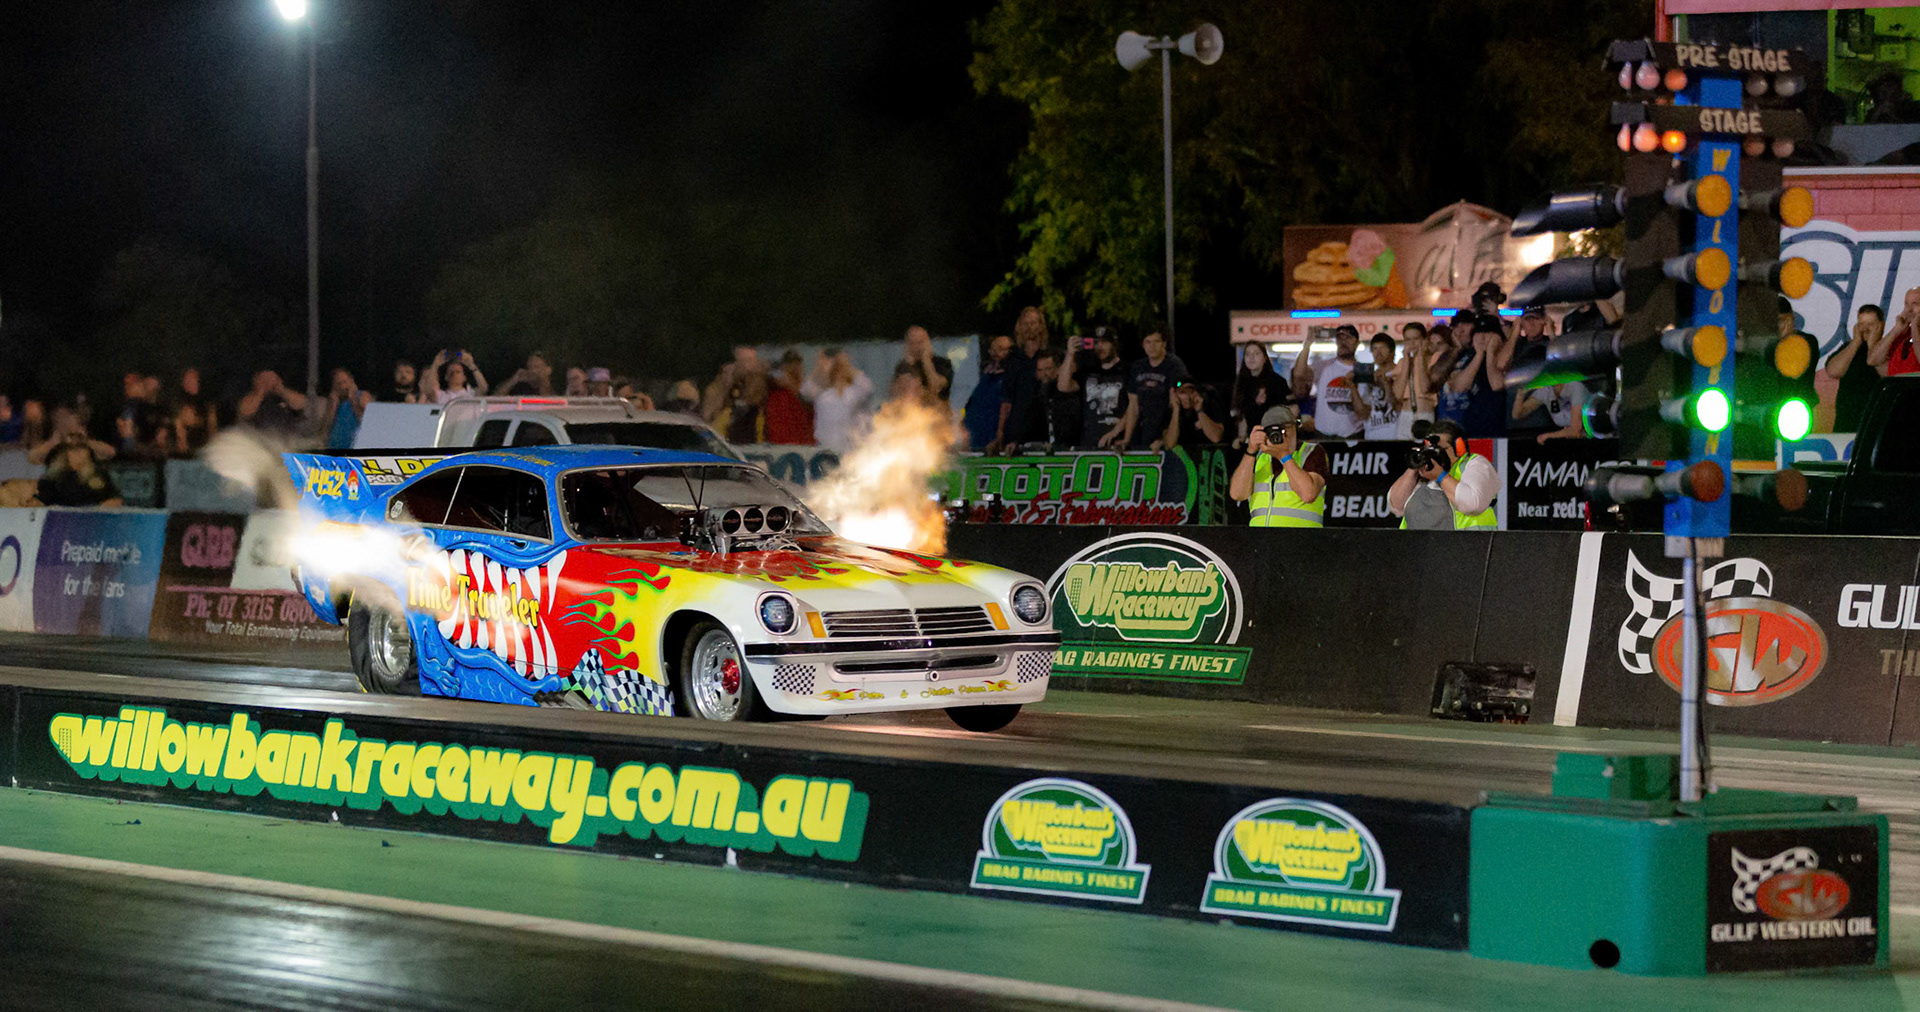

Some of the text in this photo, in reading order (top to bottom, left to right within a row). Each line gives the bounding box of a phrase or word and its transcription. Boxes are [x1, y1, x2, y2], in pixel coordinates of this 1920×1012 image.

[1675, 45, 1791, 72] PRE-STAGE
[1699, 110, 1763, 134] STAGE
[1250, 323, 1301, 336] COFFEE
[1332, 452, 1389, 475] HAIR
[1331, 495, 1391, 518] BEAU
[1518, 502, 1549, 518] Near
[62, 540, 104, 567] Prepaid
[63, 573, 80, 595] for
[1064, 562, 1219, 616] Willowbank
[183, 594, 211, 618] Ph:
[216, 595, 238, 618] 07
[407, 565, 540, 627] Time Traveler
[1106, 591, 1203, 631] Raceway
[205, 619, 224, 635] Your
[225, 621, 246, 636] Total
[246, 623, 299, 641] Earthmoving
[1083, 651, 1165, 670] RACING'S
[1169, 654, 1238, 673] FINEST
[50, 705, 852, 844] willowbankraceway.com.au
[1087, 872, 1137, 891] FINEST
[1330, 896, 1386, 917] FINEST
[1711, 916, 1877, 943] GULF WESTERN OIL
